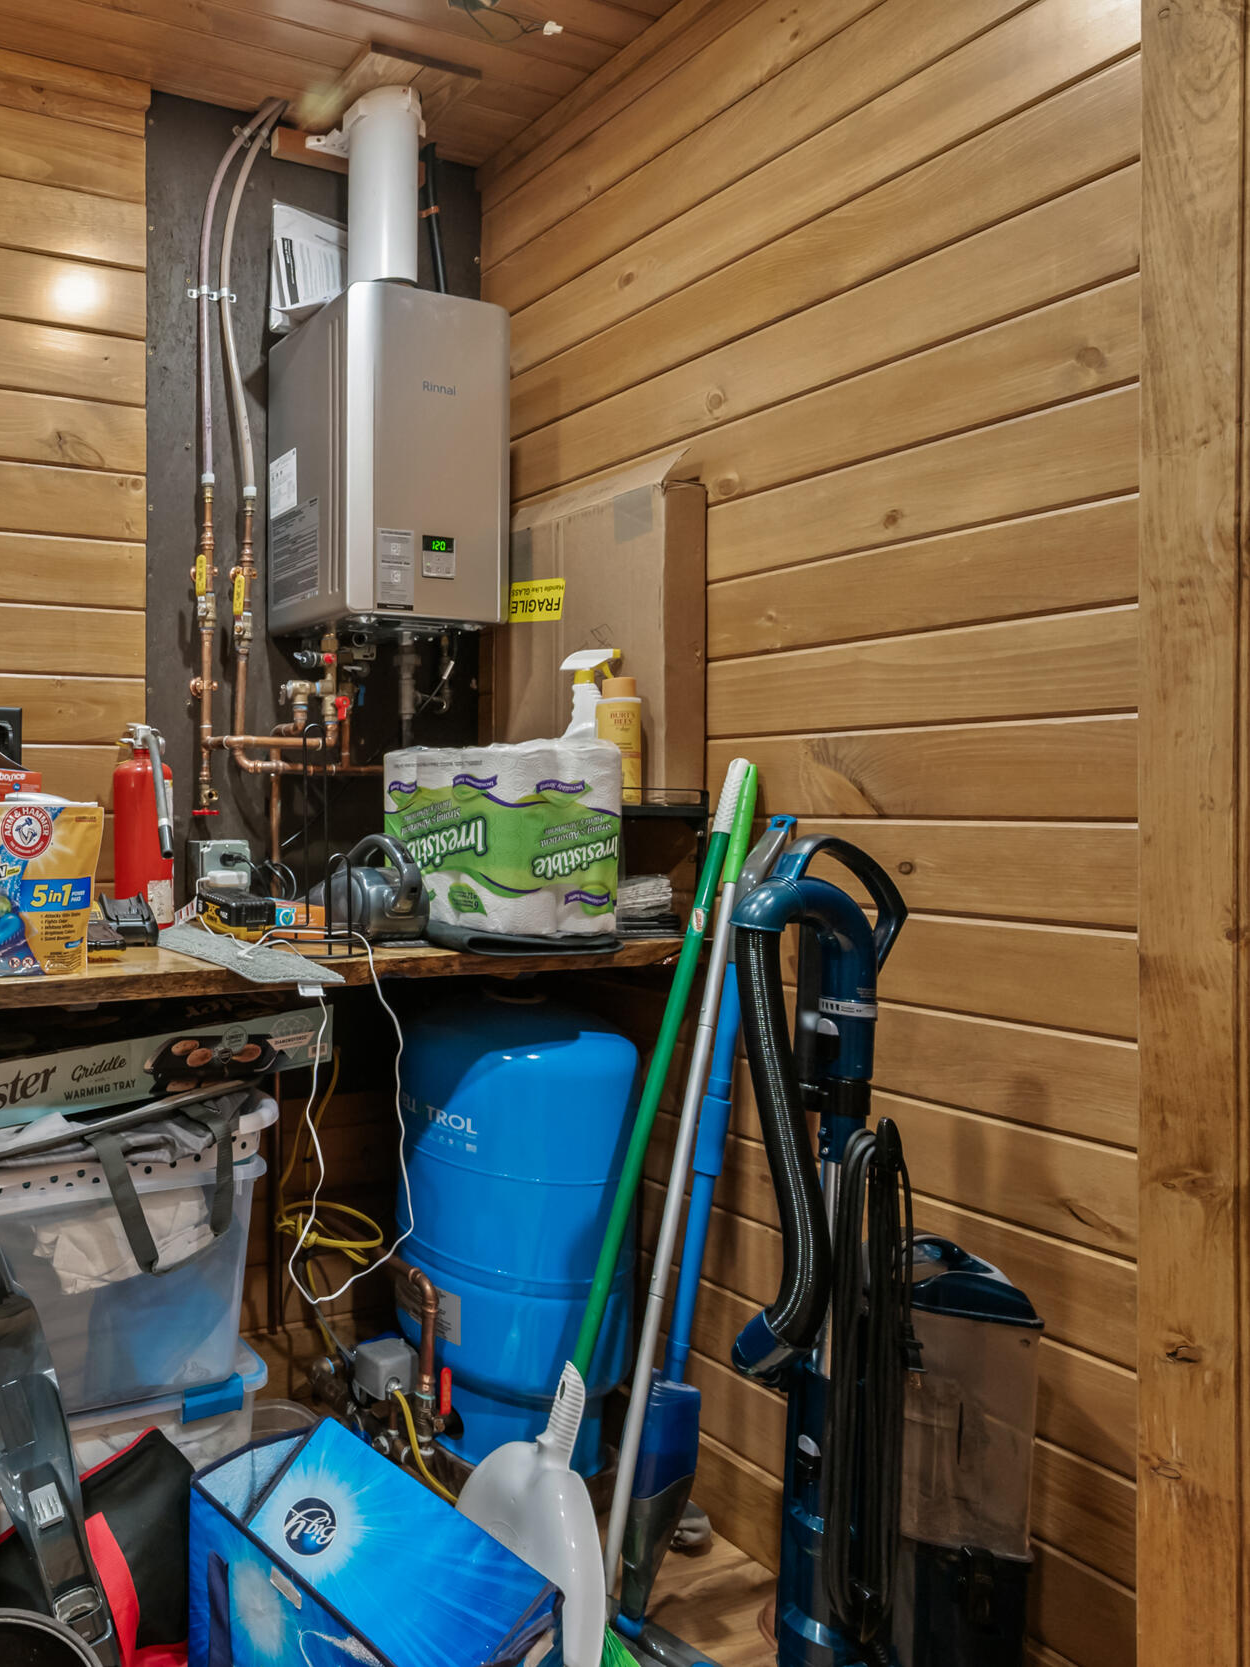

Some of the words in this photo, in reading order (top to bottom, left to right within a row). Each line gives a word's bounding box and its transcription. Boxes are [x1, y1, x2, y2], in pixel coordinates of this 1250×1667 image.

[432, 540, 446, 551] 120
[510, 597, 560, 614] FRAGILE
[5, 814, 16, 836] ARM
[22, 808, 50, 836] HAMMER
[406, 820, 484, 868] Irresistib
[533, 835, 618, 878] Irresistible
[71, 1054, 126, 1082] Griddle
[64, 1084, 111, 1101] WARMING
[114, 1079, 136, 1091] TRAY
[426, 1105, 478, 1135] TROL
